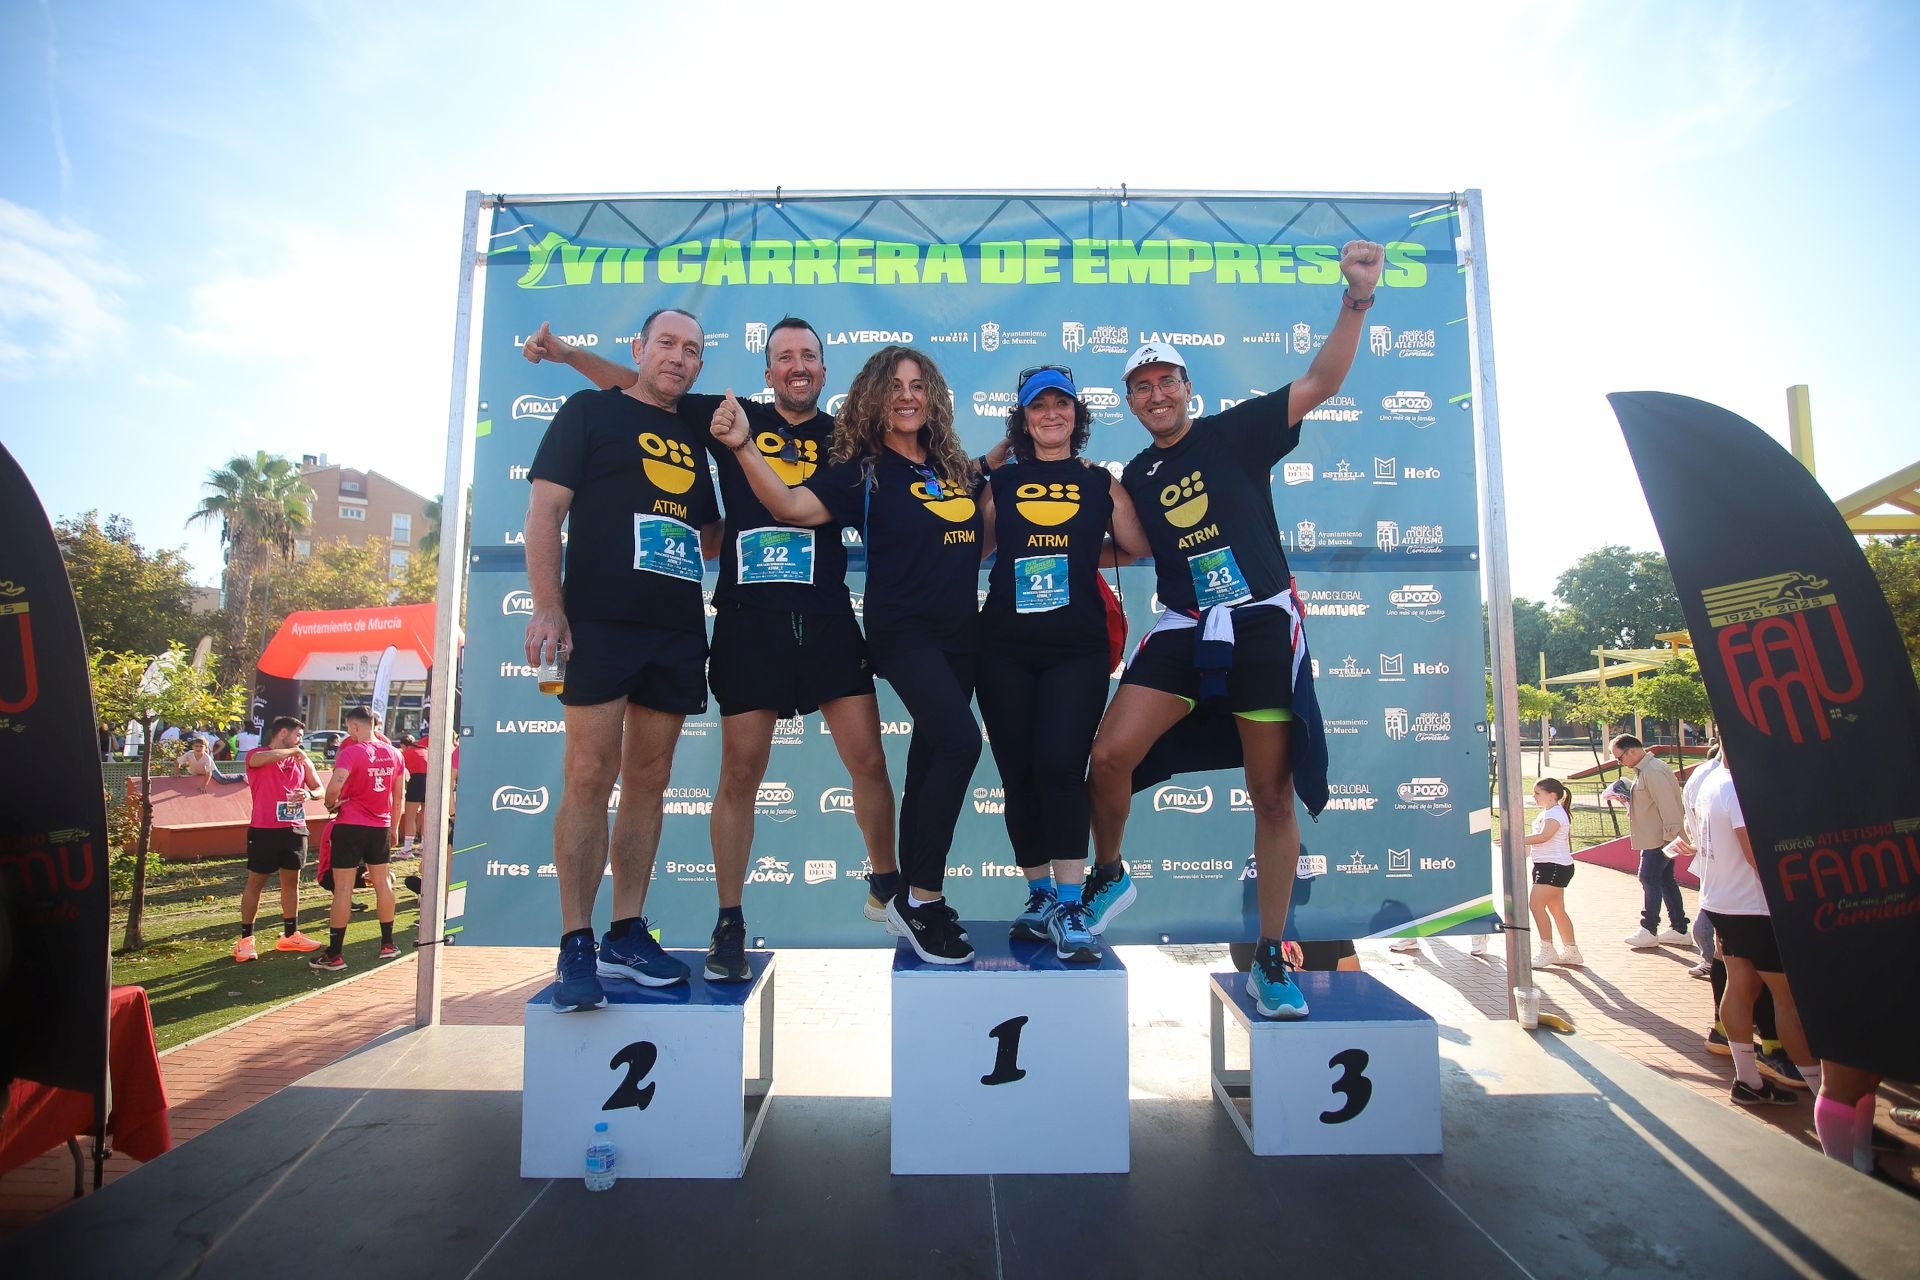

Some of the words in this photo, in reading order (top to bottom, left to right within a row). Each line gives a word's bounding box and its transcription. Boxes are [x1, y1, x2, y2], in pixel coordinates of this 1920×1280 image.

[567, 246, 653, 286] VII
[657, 238, 967, 286] CARRERA
[980, 238, 1060, 285] DE
[1073, 238, 1427, 289] EMPRESS
[827, 332, 848, 344] LA
[848, 331, 914, 343] VERDAD
[1002, 330, 1047, 339] Ayuntamiento
[1087, 337, 1129, 345] ATLETISMO
[1140, 331, 1160, 344] LA
[1162, 332, 1225, 346] VERDAD
[1394, 341, 1435, 349] ATLETISMO
[520, 402, 559, 413] VIDAL
[1404, 467, 1441, 479] Hero
[652, 499, 688, 519] ATRM
[943, 529, 975, 544] ATRM
[1027, 534, 1068, 547] ATRM
[1178, 523, 1220, 549] ATRM
[1318, 530, 1363, 539] Ayuntamiento
[1401, 537, 1444, 545] ATLETISMO
[663, 537, 686, 558] 24
[1327, 538, 1353, 546] Murcia
[763, 546, 788, 563] 22
[1030, 573, 1053, 591] 21
[1206, 566, 1232, 588] 23
[511, 597, 534, 609] VID
[1724, 607, 1764, 624] 1925
[1776, 598, 1823, 614] 2025
[291, 620, 352, 637] Ayuntamiento
[354, 619, 366, 632] de
[1328, 667, 1372, 675] ESTRELLA
[1412, 662, 1450, 675] Hero
[496, 720, 517, 733] LA
[1410, 724, 1451, 732] ATLETISMO
[679, 787, 711, 798] GLOBAL
[500, 793, 541, 806] VIDAL
[829, 795, 854, 807] VID
[1163, 793, 1205, 806] VIDAL
[486, 860, 530, 876] itres
[1162, 858, 1233, 871] Brocalsa
[1336, 863, 1379, 871] ESTRELLA
[1420, 857, 1456, 870] Hero
[980, 1015, 1029, 1086] 1
[601, 1040, 658, 1111] 2
[1319, 1048, 1373, 1124] 3
